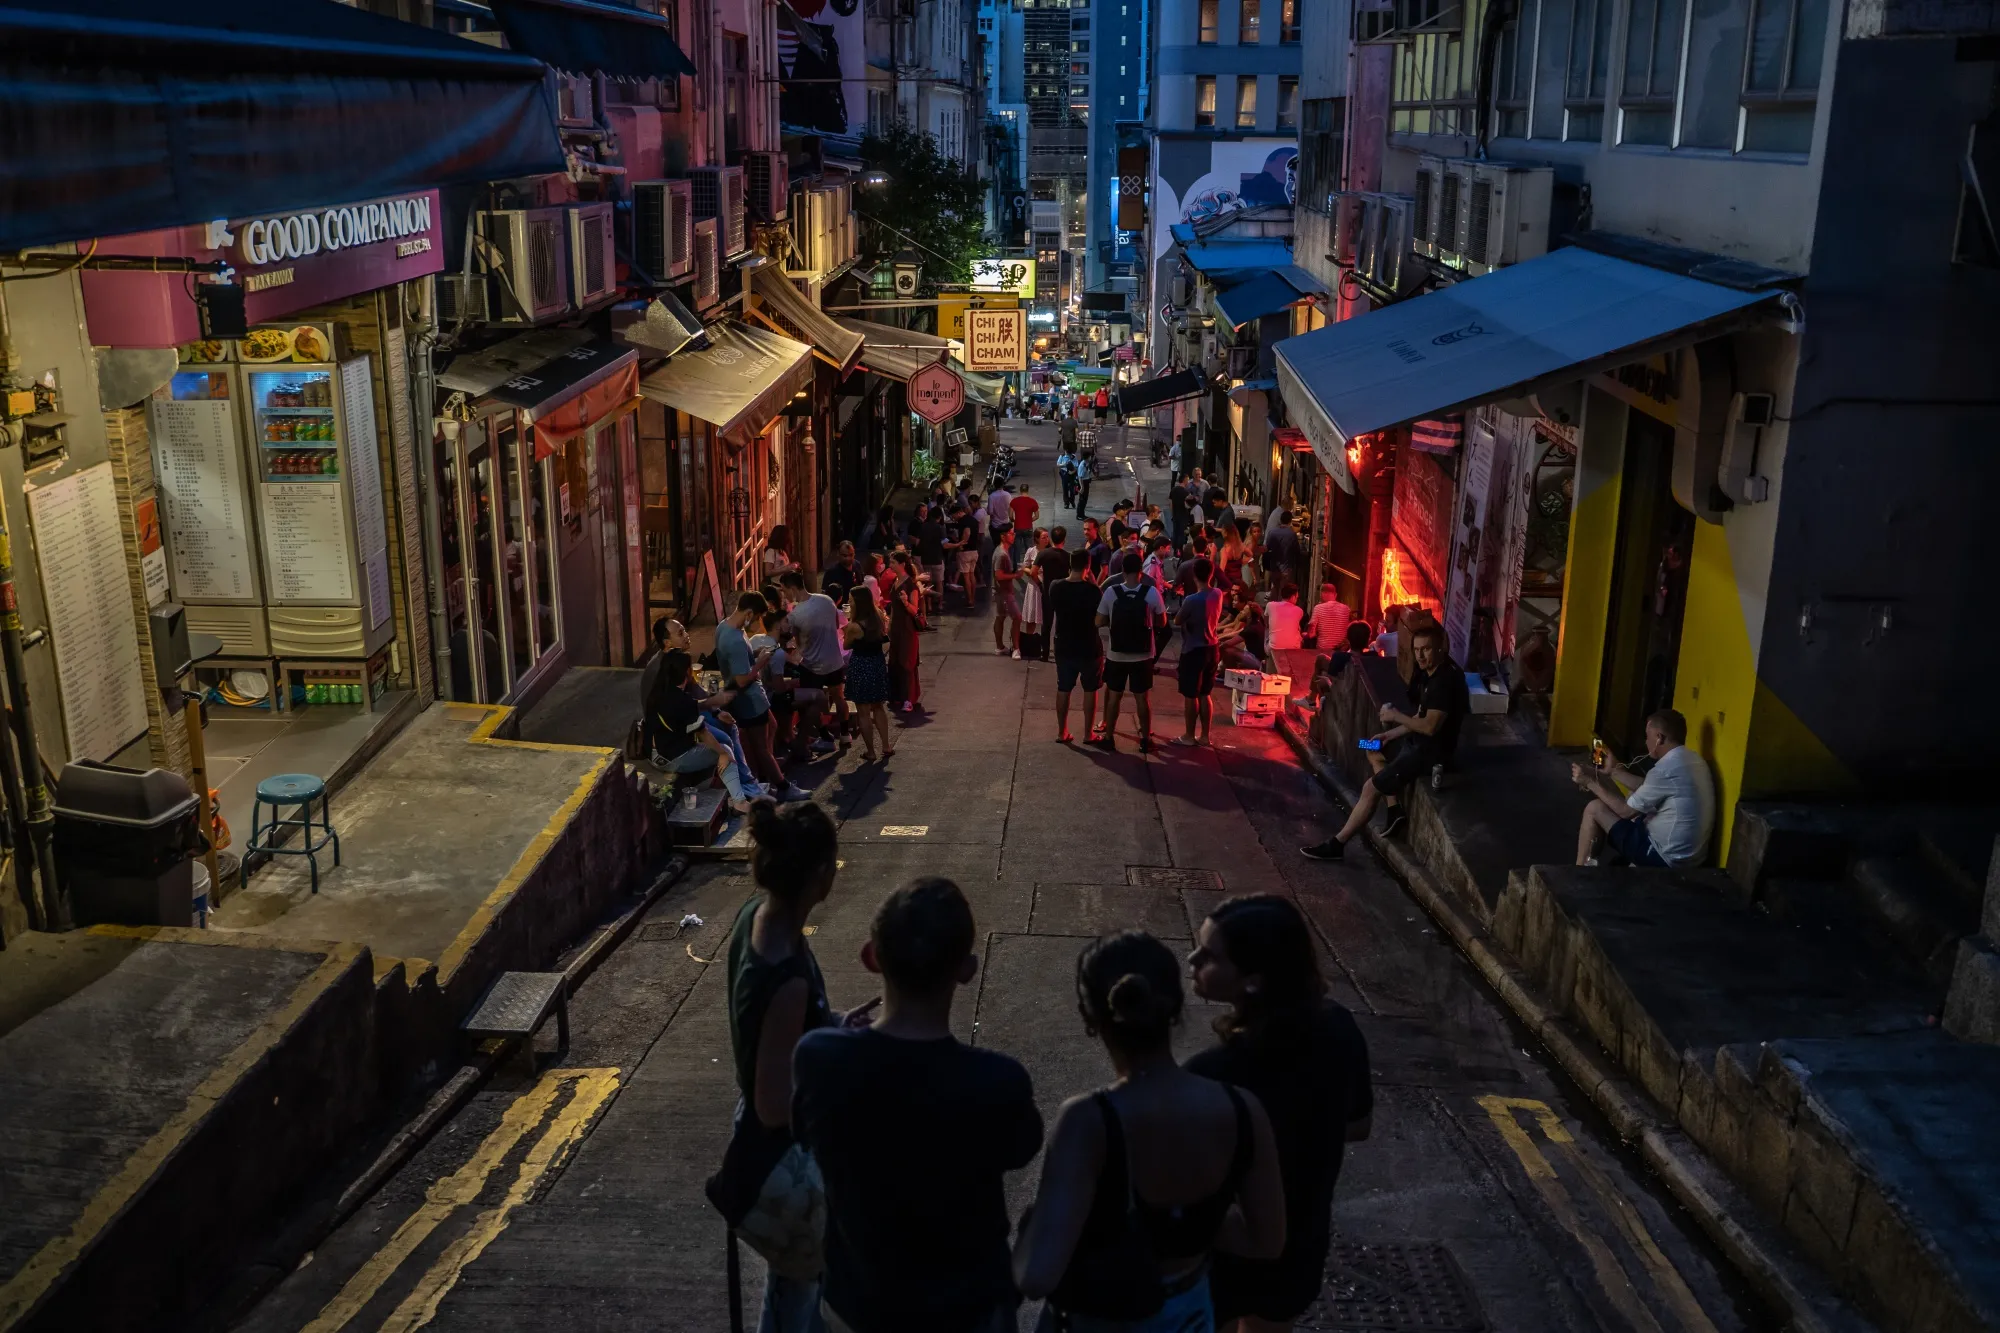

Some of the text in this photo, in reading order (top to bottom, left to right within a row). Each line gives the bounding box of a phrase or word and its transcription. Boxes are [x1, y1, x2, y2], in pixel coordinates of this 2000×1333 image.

[245, 213, 320, 265] GOOD
[324, 197, 431, 250] COMPANION
[976, 317, 995, 328] CHI
[976, 332, 995, 343] CHI
[976, 348, 1014, 358] CHAM
[932, 379, 940, 390] le
[916, 389, 956, 398] moment
